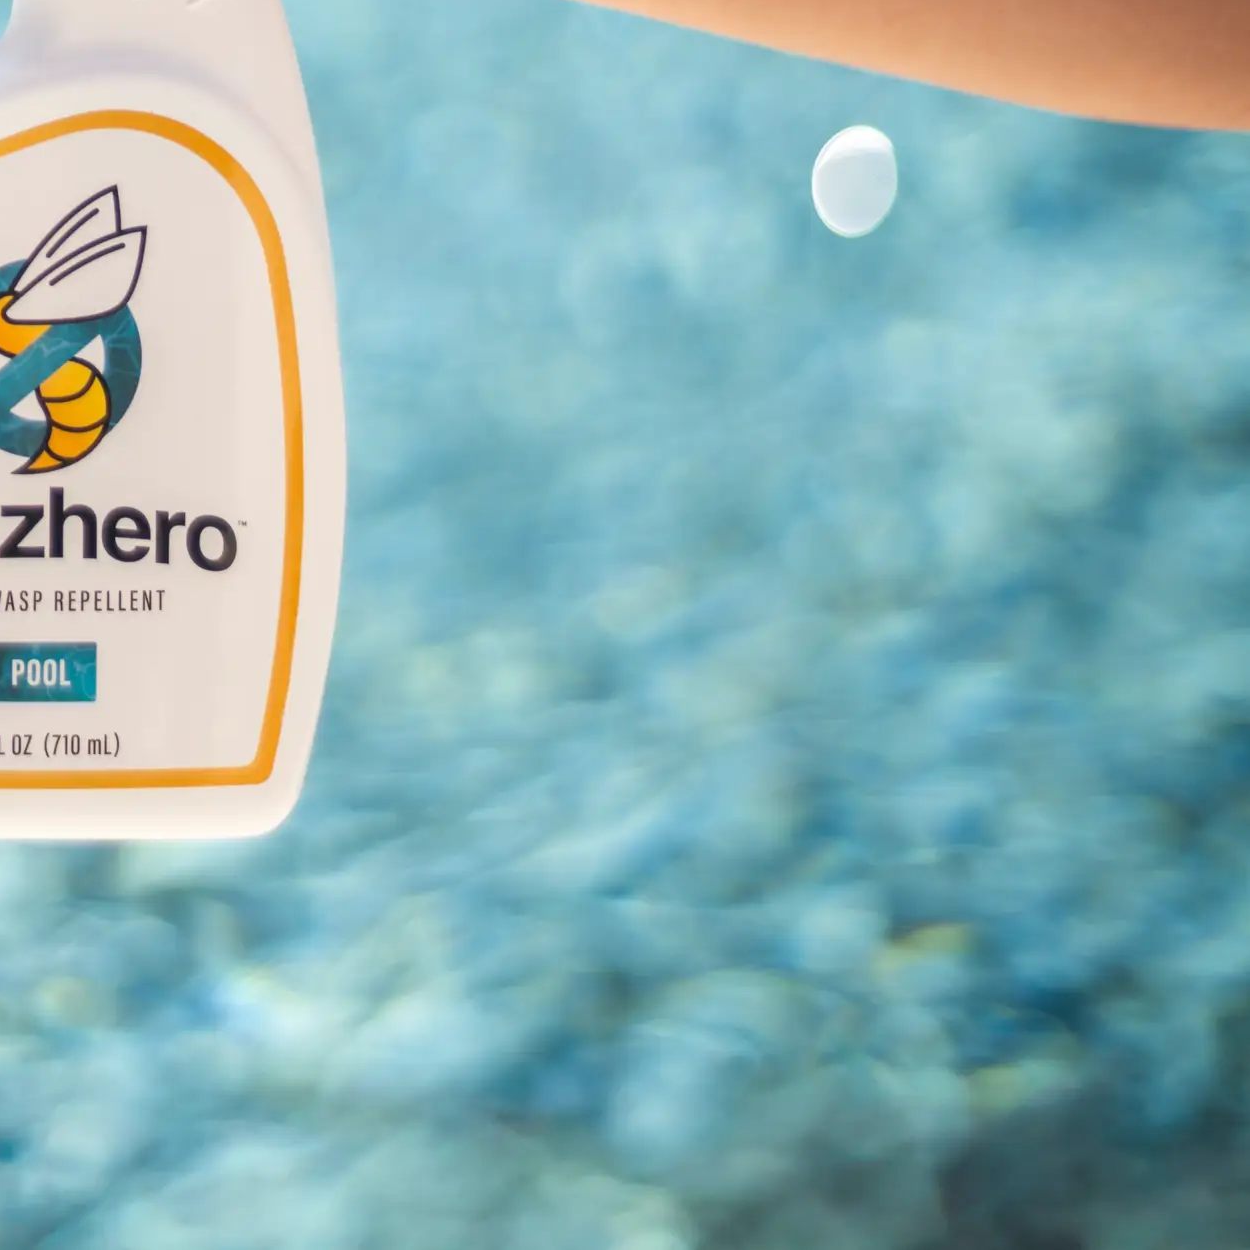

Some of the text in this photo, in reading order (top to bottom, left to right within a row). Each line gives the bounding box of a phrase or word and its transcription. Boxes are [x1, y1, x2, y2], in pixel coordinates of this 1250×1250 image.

[54, 589, 166, 612] REPELLENT
[11, 658, 72, 687] POOL
[11, 734, 33, 756] OZ
[43, 732, 82, 758] (710
[87, 732, 121, 758] mL)
